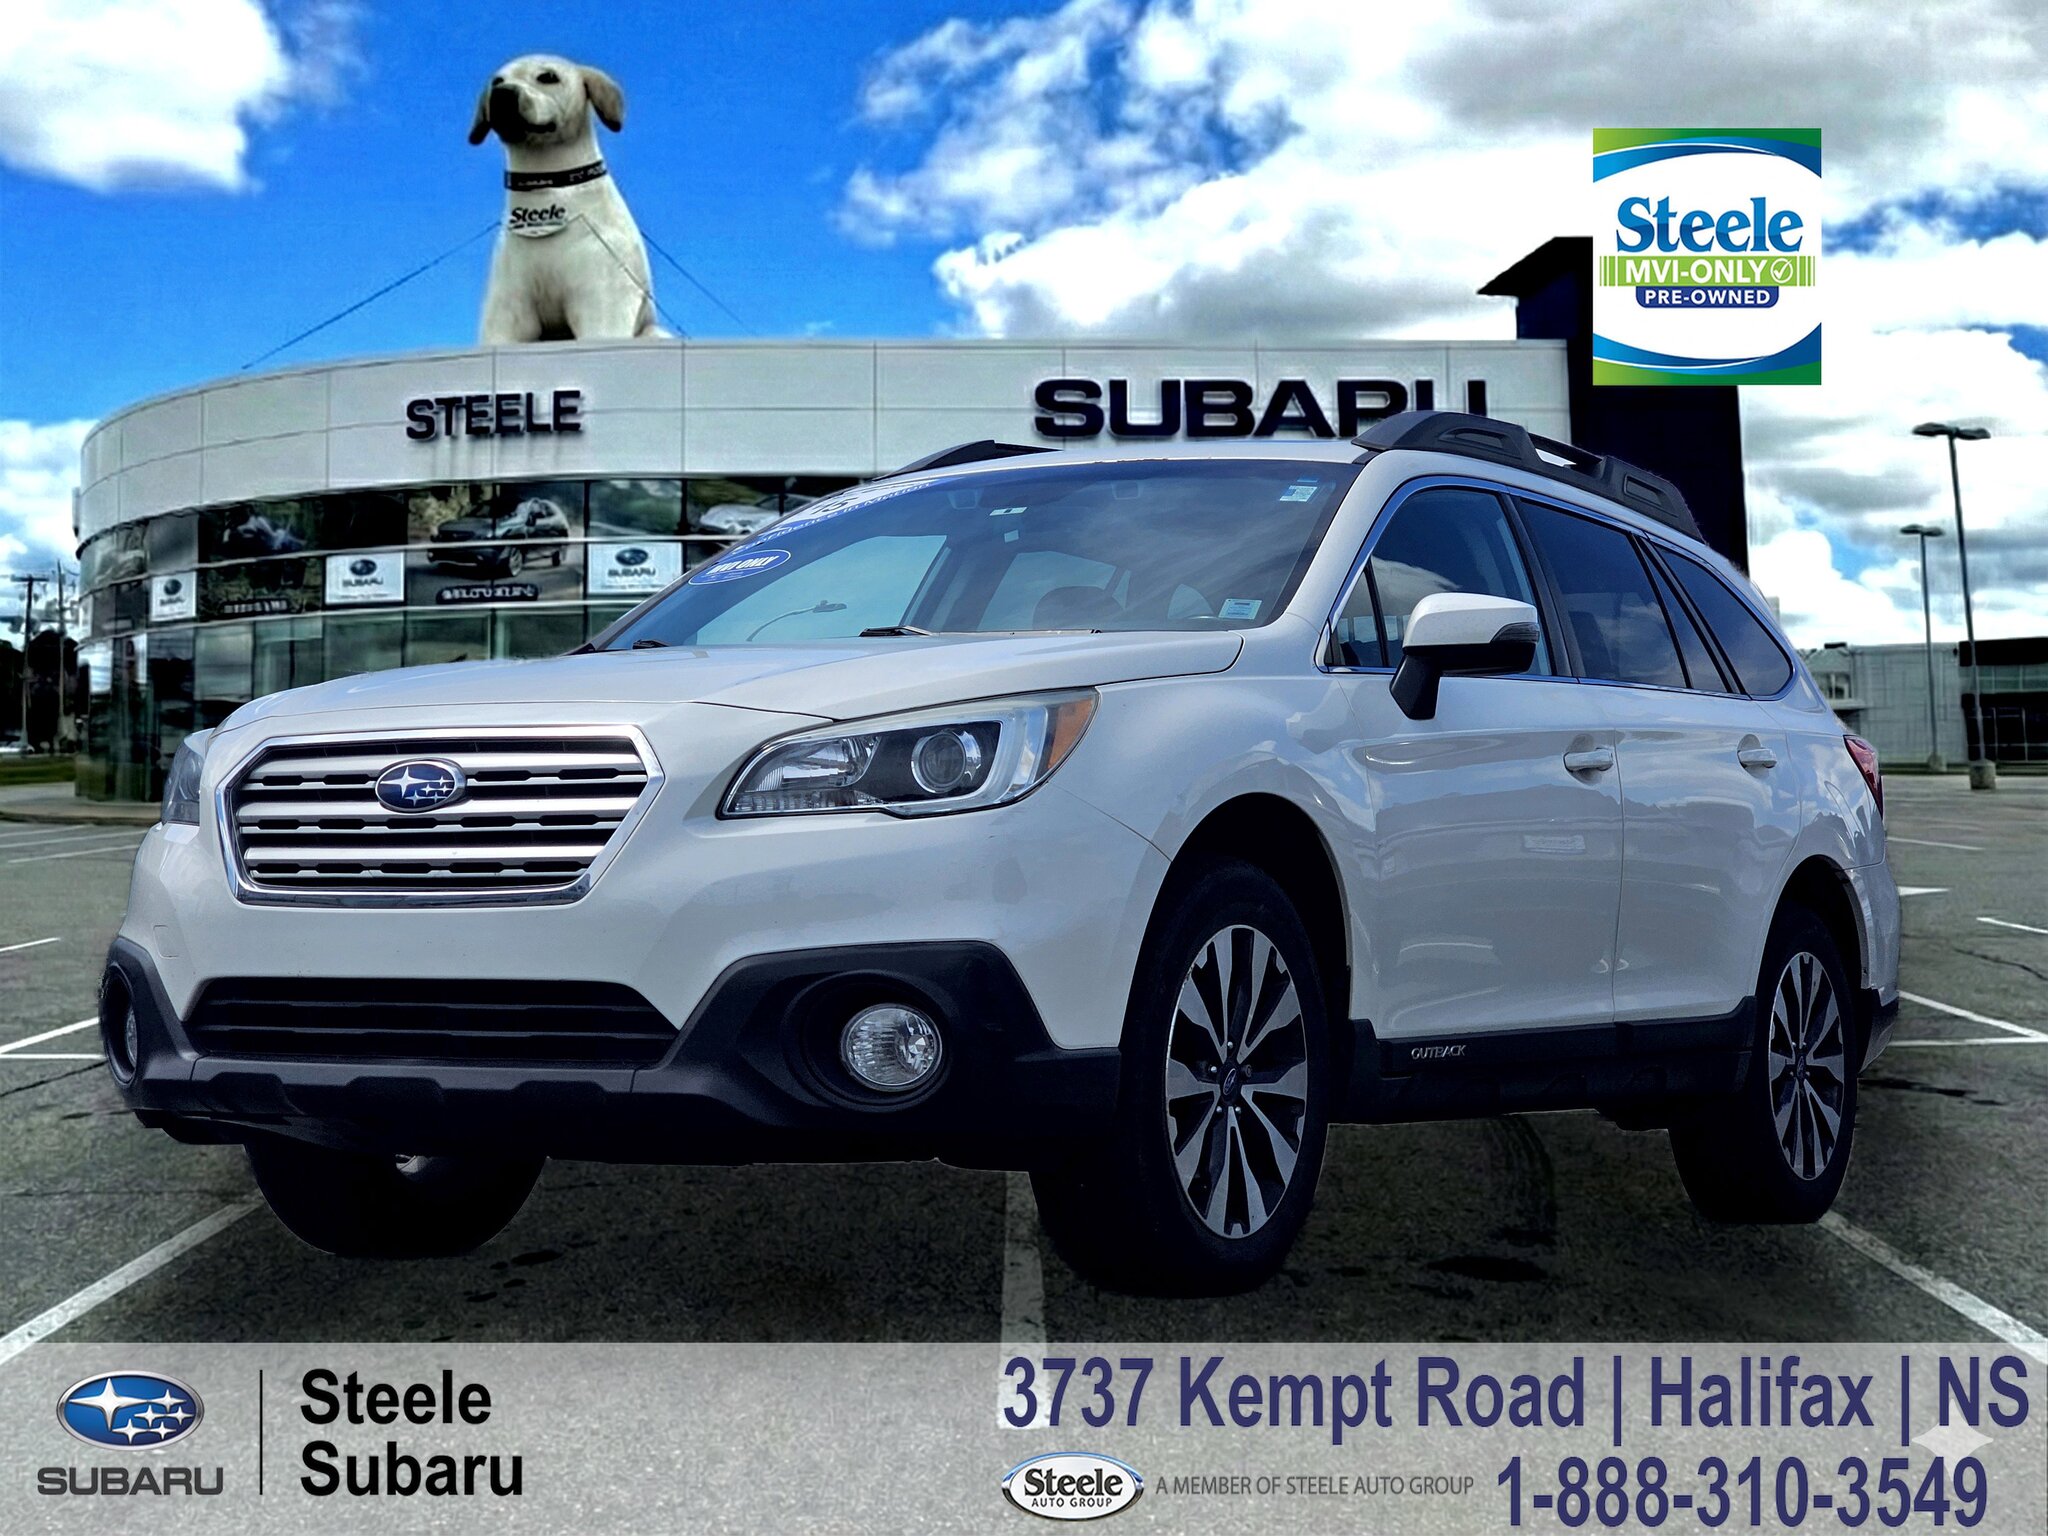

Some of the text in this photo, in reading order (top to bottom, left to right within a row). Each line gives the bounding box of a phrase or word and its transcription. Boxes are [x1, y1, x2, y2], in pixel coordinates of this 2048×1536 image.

[509, 204, 566, 224] Steele
[406, 390, 581, 439] STEELE
[1411, 1044, 1467, 1060] OUTBACK
